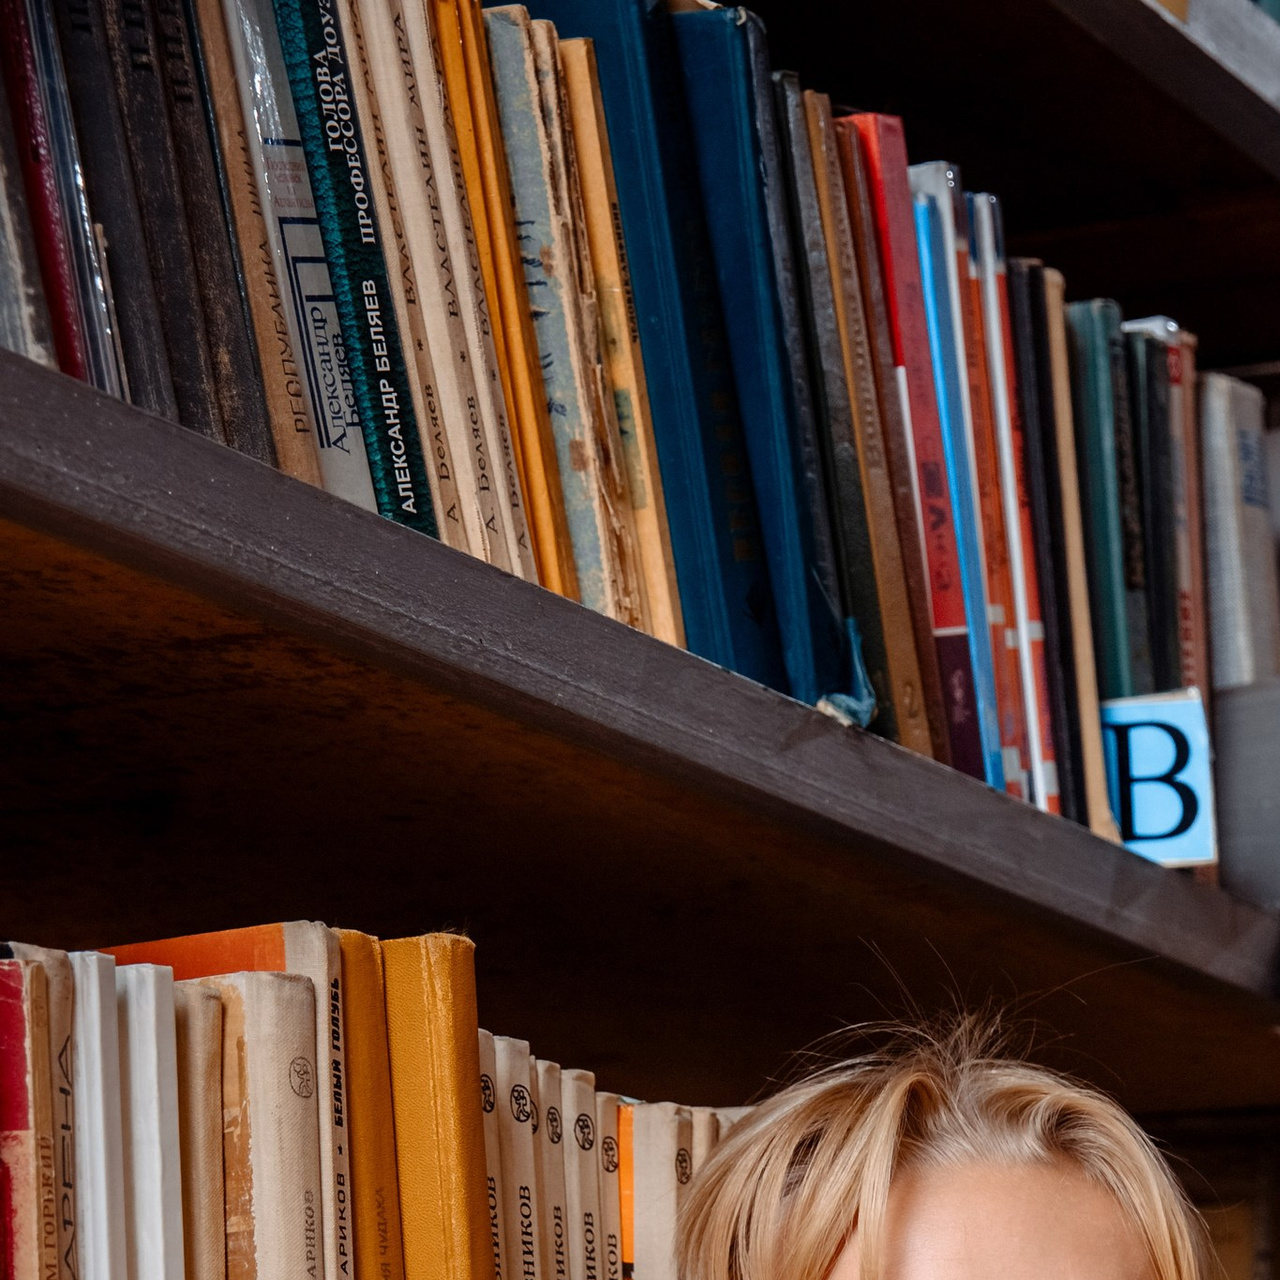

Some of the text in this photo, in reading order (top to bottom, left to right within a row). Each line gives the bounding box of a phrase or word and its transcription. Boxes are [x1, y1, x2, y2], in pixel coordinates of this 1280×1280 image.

[313, 49, 343, 152] ГОЛОВА
[333, 72, 376, 245] ПРОФЕССОРА
[371, 113, 416, 305] ВЛАСТЕЛИН
[394, 12, 498, 535] А. Беляев ВЛАСТЕЛИН МИРА
[310, 305, 351, 455] Александр
[331, 332, 362, 428] Беляев
[362, 278, 418, 515] АЛЕКСАНДР БЕЛЯЕВ
[423, 383, 450, 482] Беляев
[1101, 721, 1200, 842] В
[329, 977, 342, 1053] ГОЛУБЬ
[333, 1058, 344, 1128] БЕЛЫЙ
